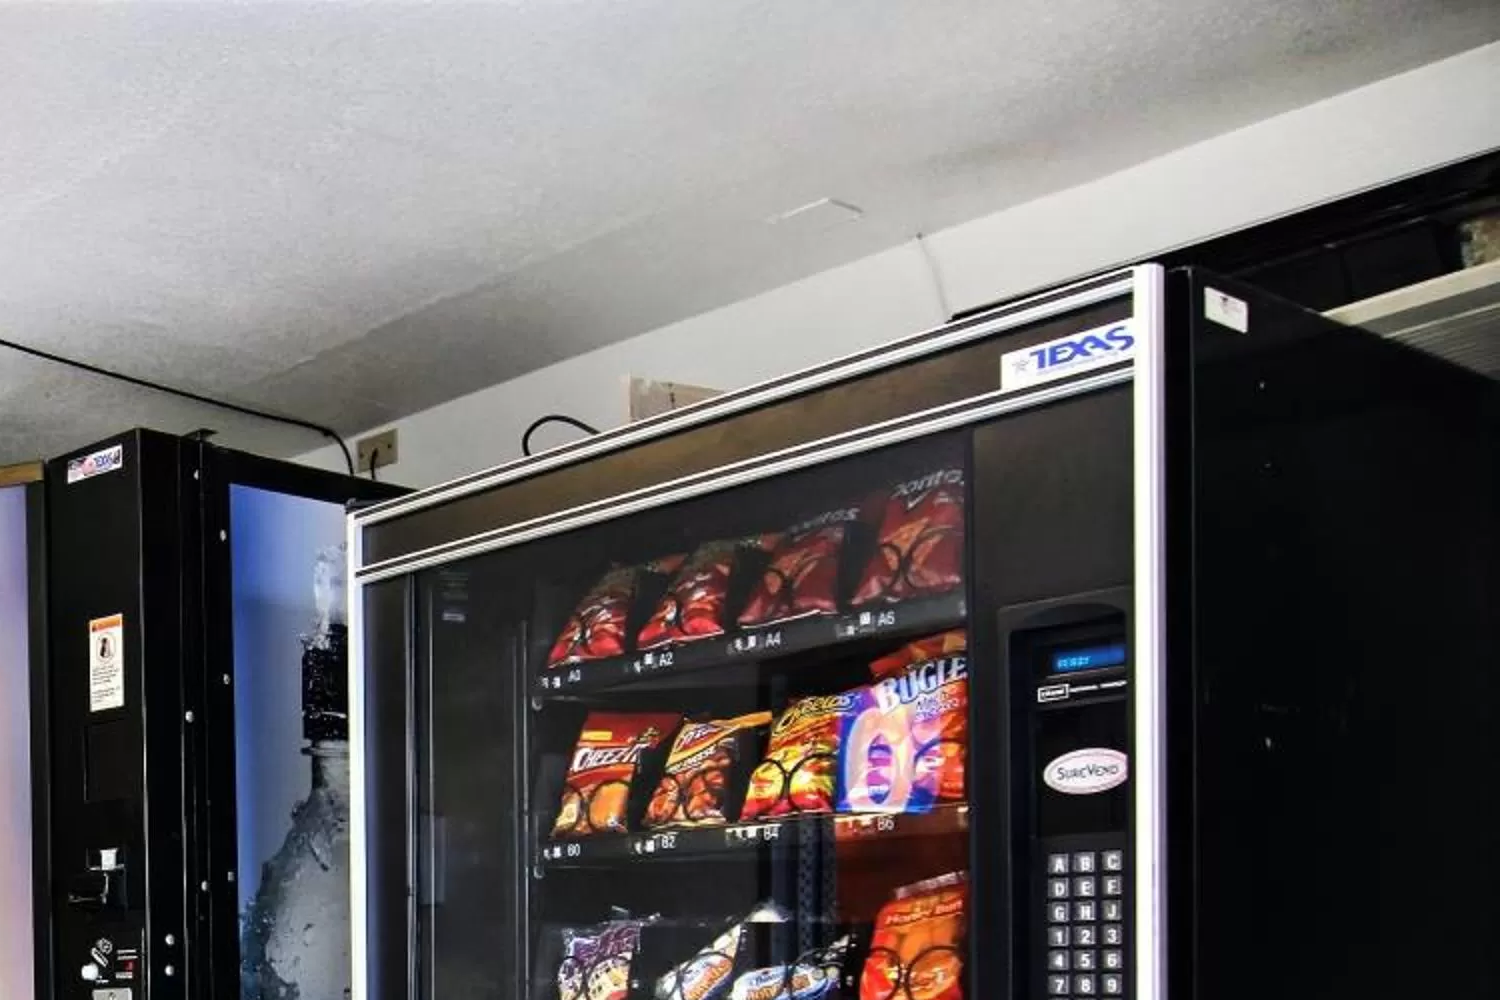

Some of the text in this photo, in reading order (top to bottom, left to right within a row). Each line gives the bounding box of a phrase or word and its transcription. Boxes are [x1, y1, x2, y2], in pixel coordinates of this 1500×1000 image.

[1029, 325, 1135, 369] TEXAS
[877, 611, 895, 626] A6
[765, 631, 781, 647] A4
[658, 652, 674, 666] A2
